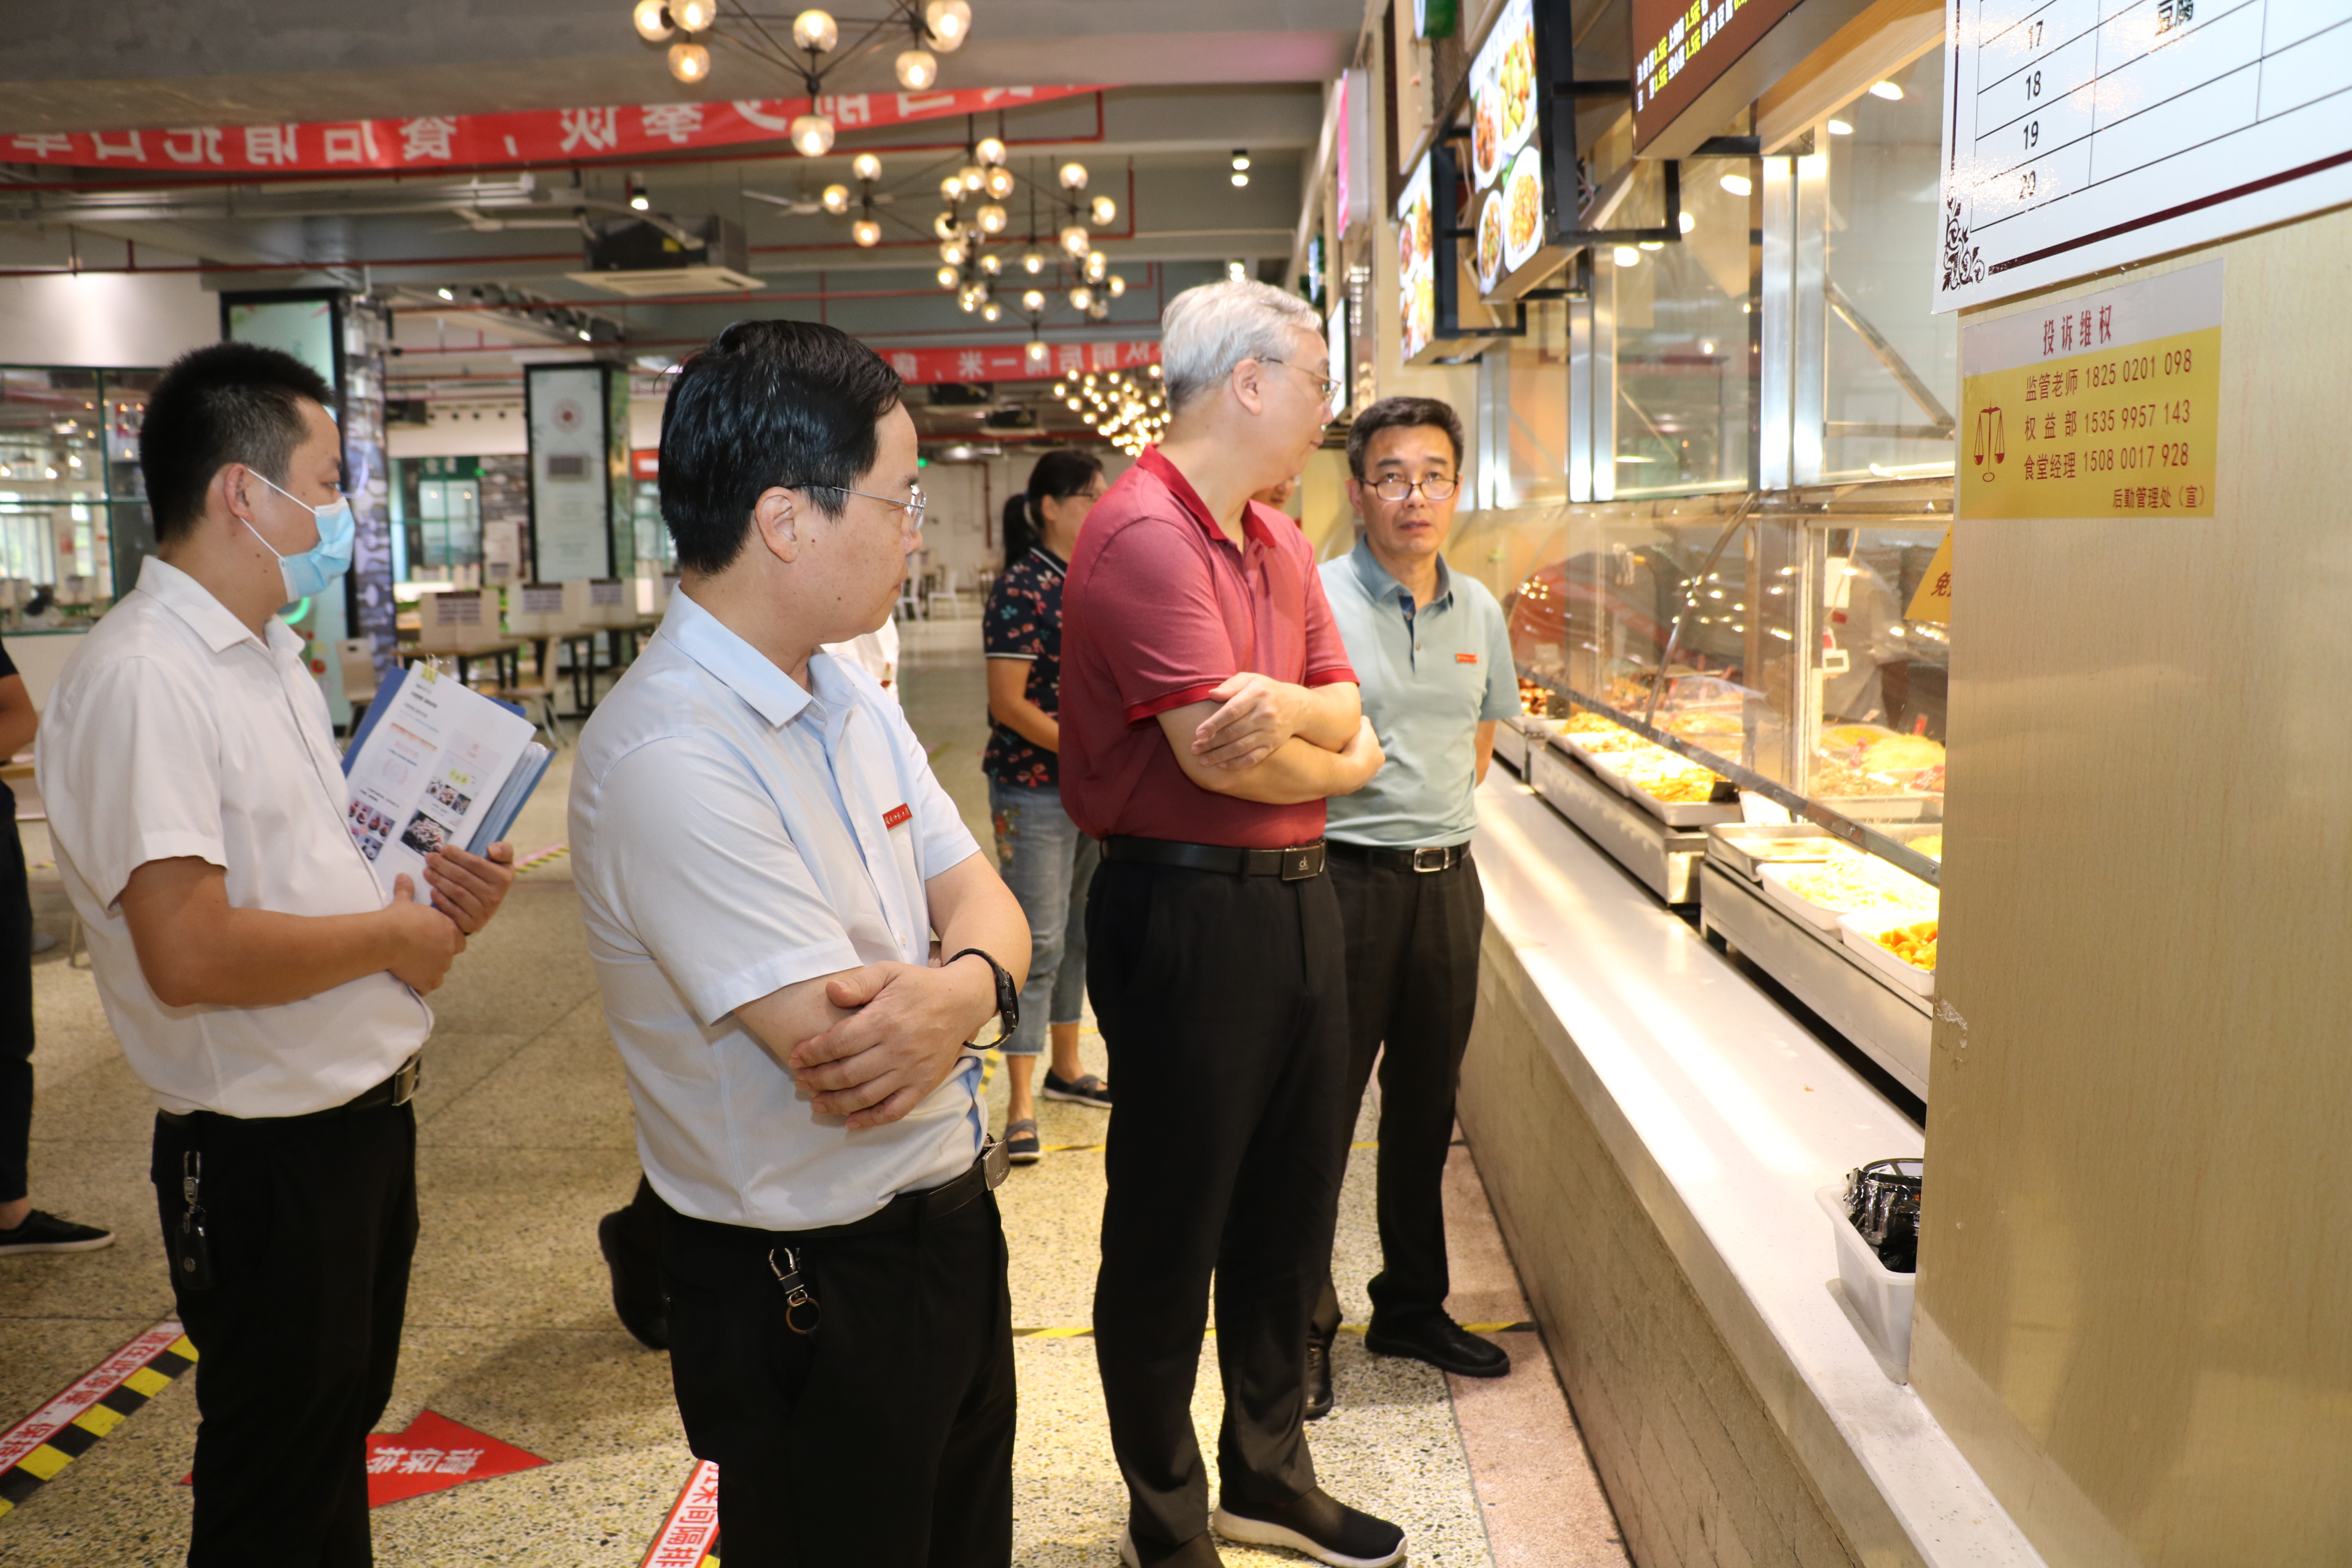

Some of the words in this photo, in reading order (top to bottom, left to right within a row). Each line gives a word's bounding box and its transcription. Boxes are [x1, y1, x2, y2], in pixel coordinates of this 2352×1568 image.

[2028, 19, 2044, 51] 17
[2025, 71, 2041, 101] 18
[2023, 121, 2038, 151] 19
[2019, 171, 2036, 201] 20
[2043, 305, 2112, 356] 投诉维权
[2025, 368, 2078, 402] 监管老师
[2086, 363, 2116, 388] 1825
[2123, 355, 2155, 382] 0201
[2165, 348, 2192, 376] 098
[2085, 409, 2115, 433] 1535
[2122, 404, 2156, 430] 9957
[2164, 399, 2190, 425] 143
[2024, 452, 2076, 481] 食堂经理
[2083, 448, 2114, 472] 1508
[2121, 445, 2155, 469] 0017
[2162, 442, 2189, 467] 928
[1930, 571, 1951, 597] 免
[1299, 857, 1308, 867] ck
